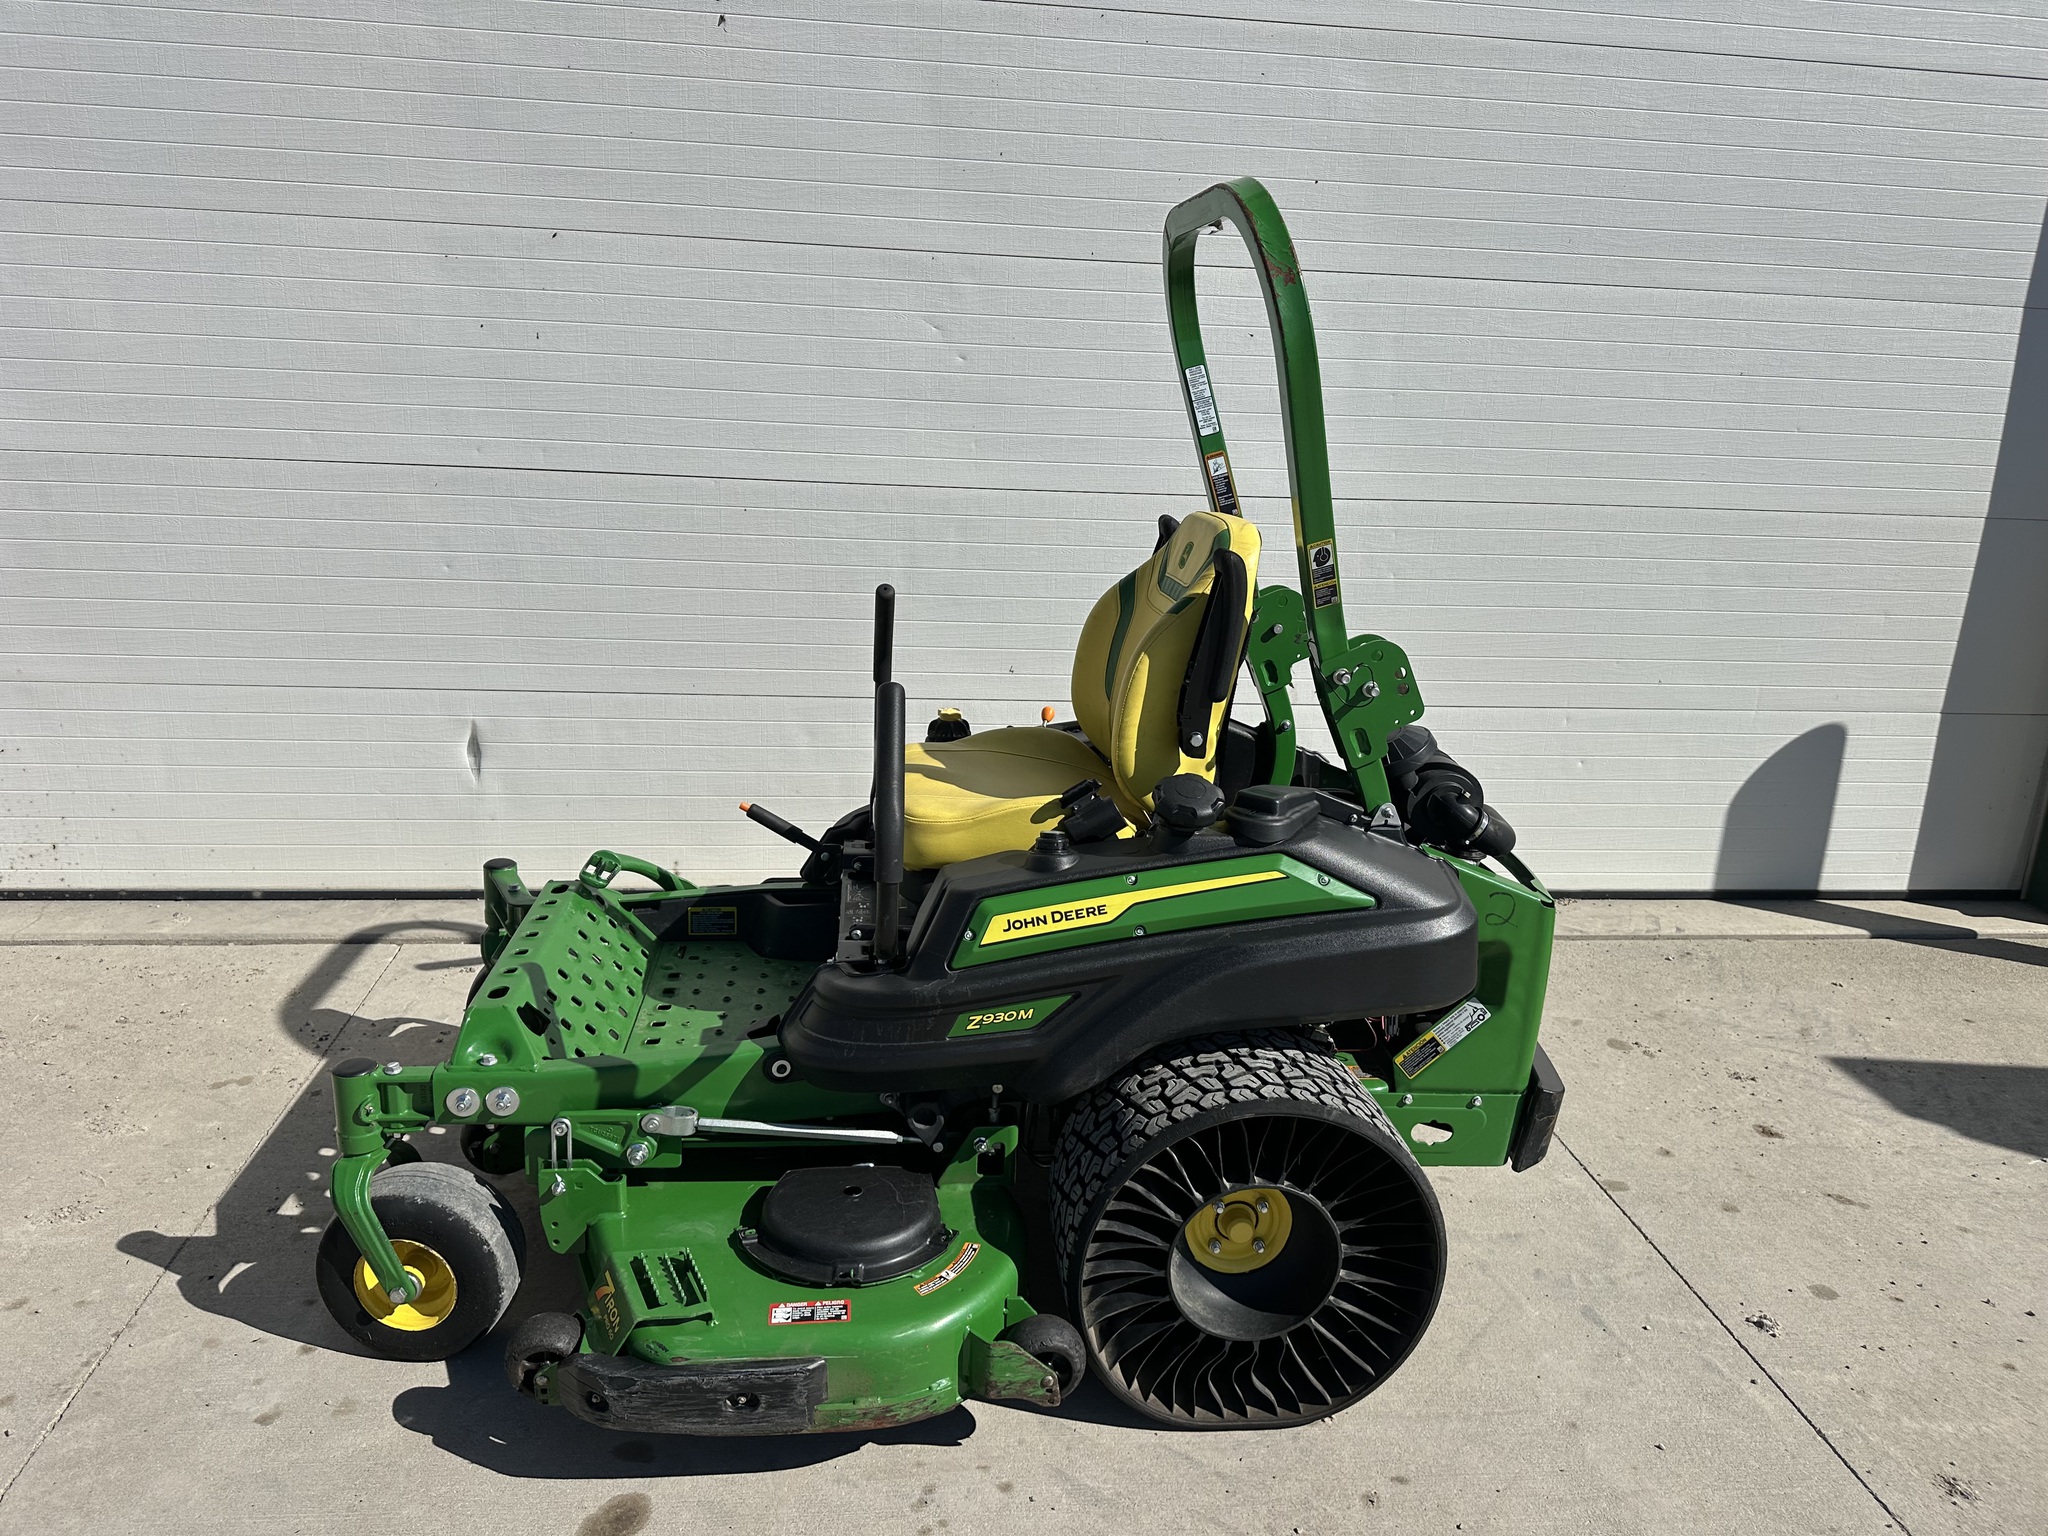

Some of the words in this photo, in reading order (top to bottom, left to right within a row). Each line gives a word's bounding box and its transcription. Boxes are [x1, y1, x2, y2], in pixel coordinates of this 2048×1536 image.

[1002, 914, 1048, 932] JOHN
[1050, 904, 1108, 924] DEERE
[966, 1008, 1034, 1030] Z930M
